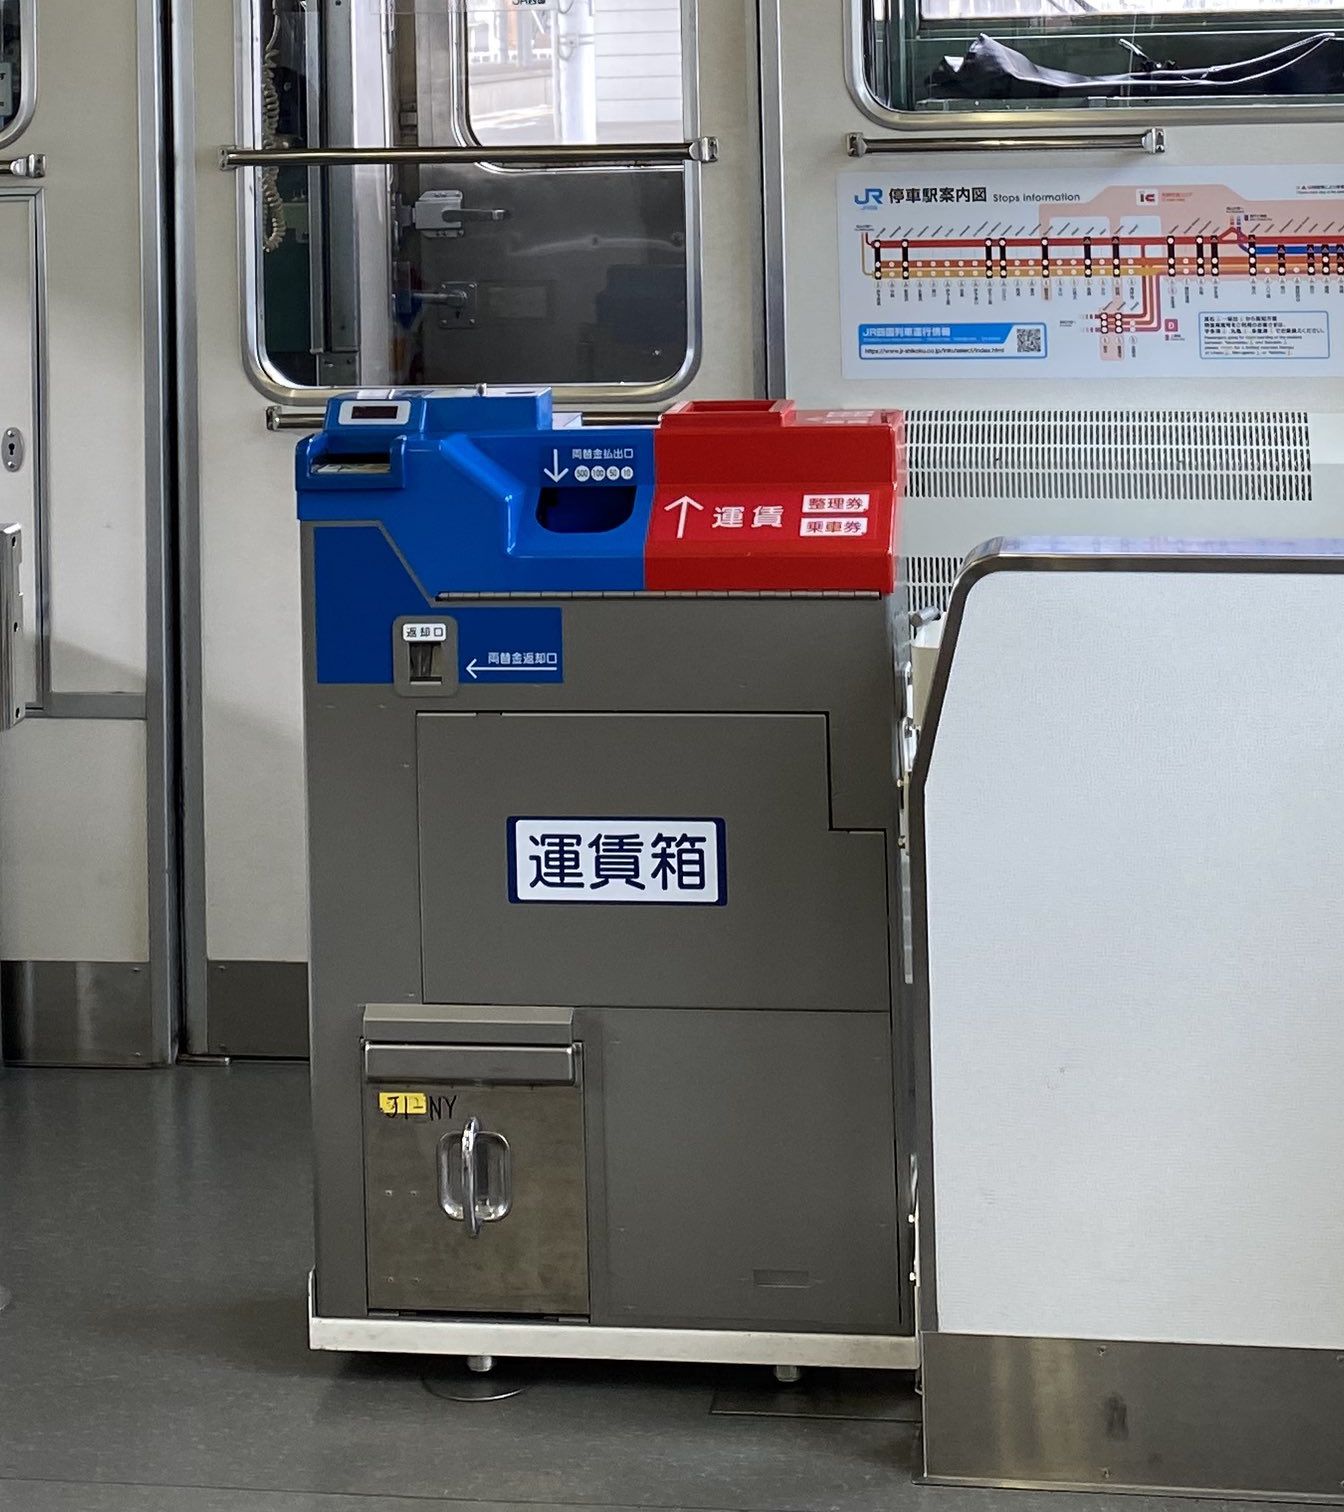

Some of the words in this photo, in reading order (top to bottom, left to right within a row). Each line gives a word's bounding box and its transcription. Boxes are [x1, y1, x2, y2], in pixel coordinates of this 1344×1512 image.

[854, 188, 884, 206] JR
[888, 186, 987, 204] 停車駅案内図
[993, 192, 1019, 203] Stops
[572, 448, 634, 459] 両替金払出口
[576, 468, 588, 478] 500
[592, 468, 605, 478] 100
[609, 467, 618, 478] 50
[807, 496, 864, 511] 整理券
[711, 505, 784, 529] 運賃
[807, 520, 862, 534] 乗車券
[405, 625, 445, 639] 返却口
[487, 651, 558, 665] 両替金返却口
[528, 832, 708, 891] 運賃箱
